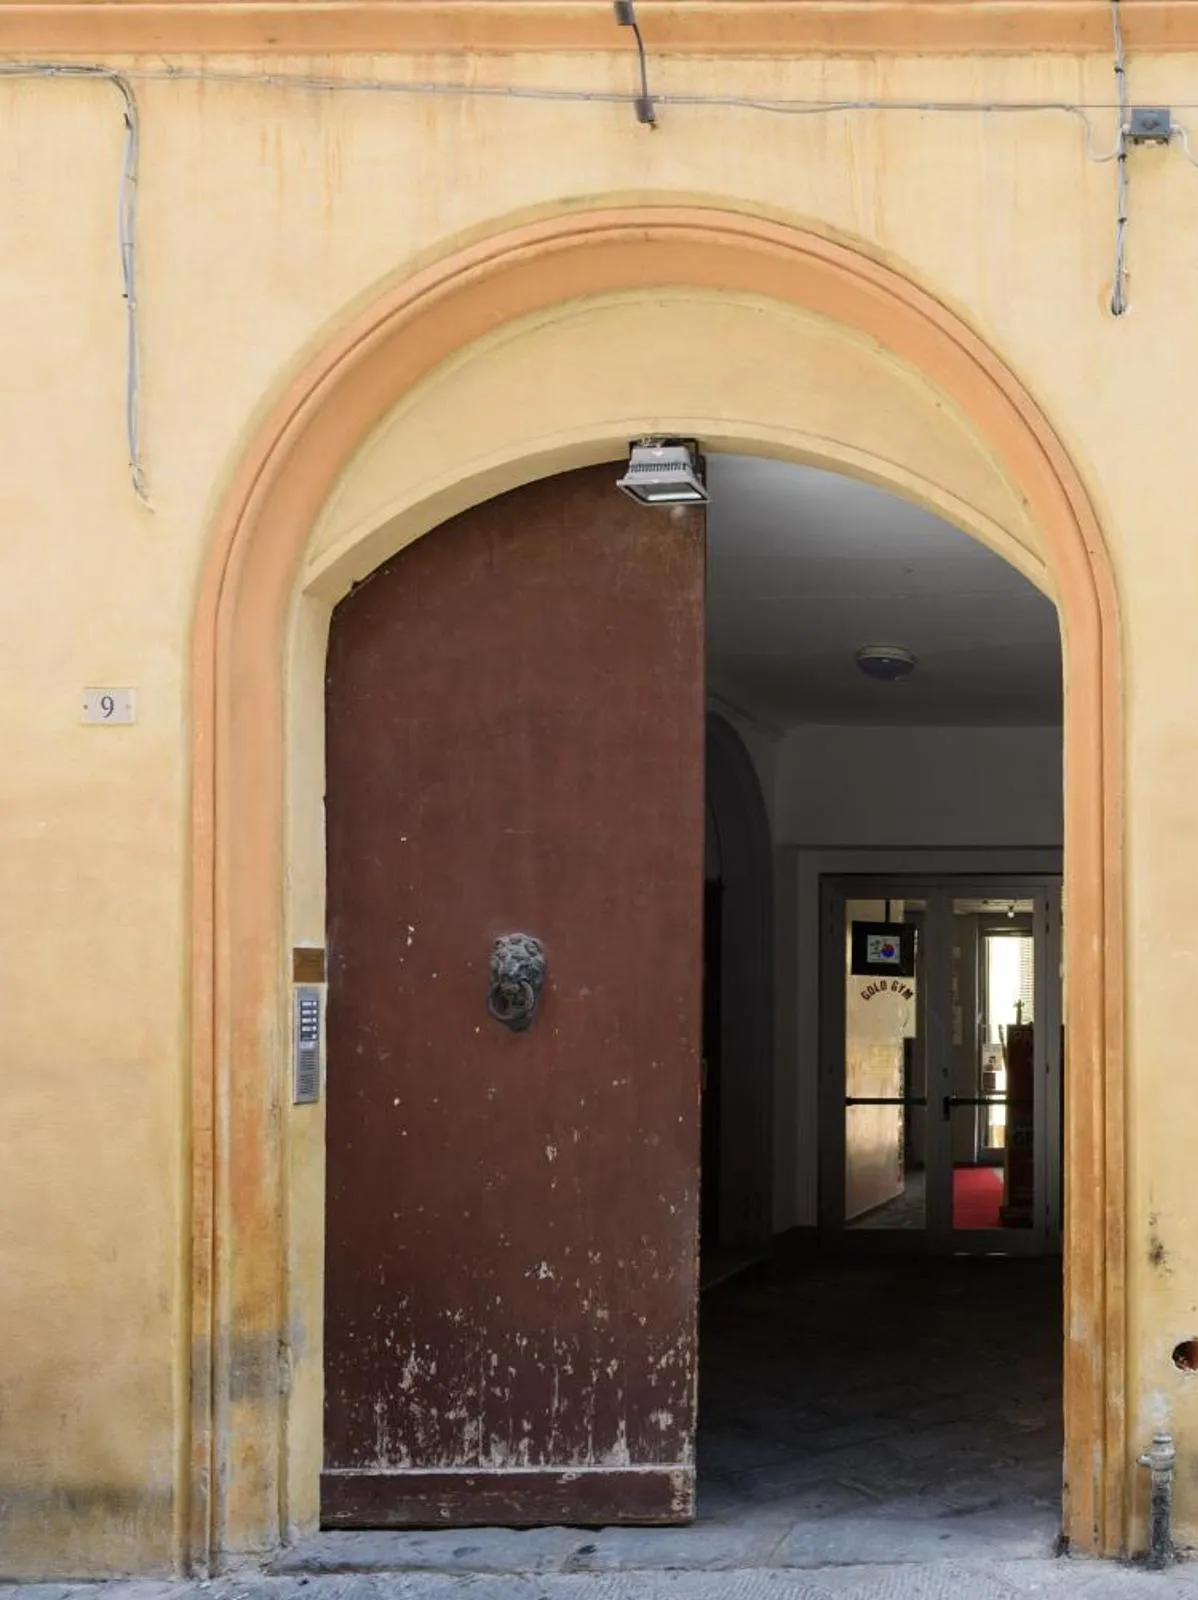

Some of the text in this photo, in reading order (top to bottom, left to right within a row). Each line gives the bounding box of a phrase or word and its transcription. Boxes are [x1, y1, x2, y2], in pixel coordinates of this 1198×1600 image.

[101, 695, 114, 718] 9
[860, 980, 914, 1000] GOLD GYM
